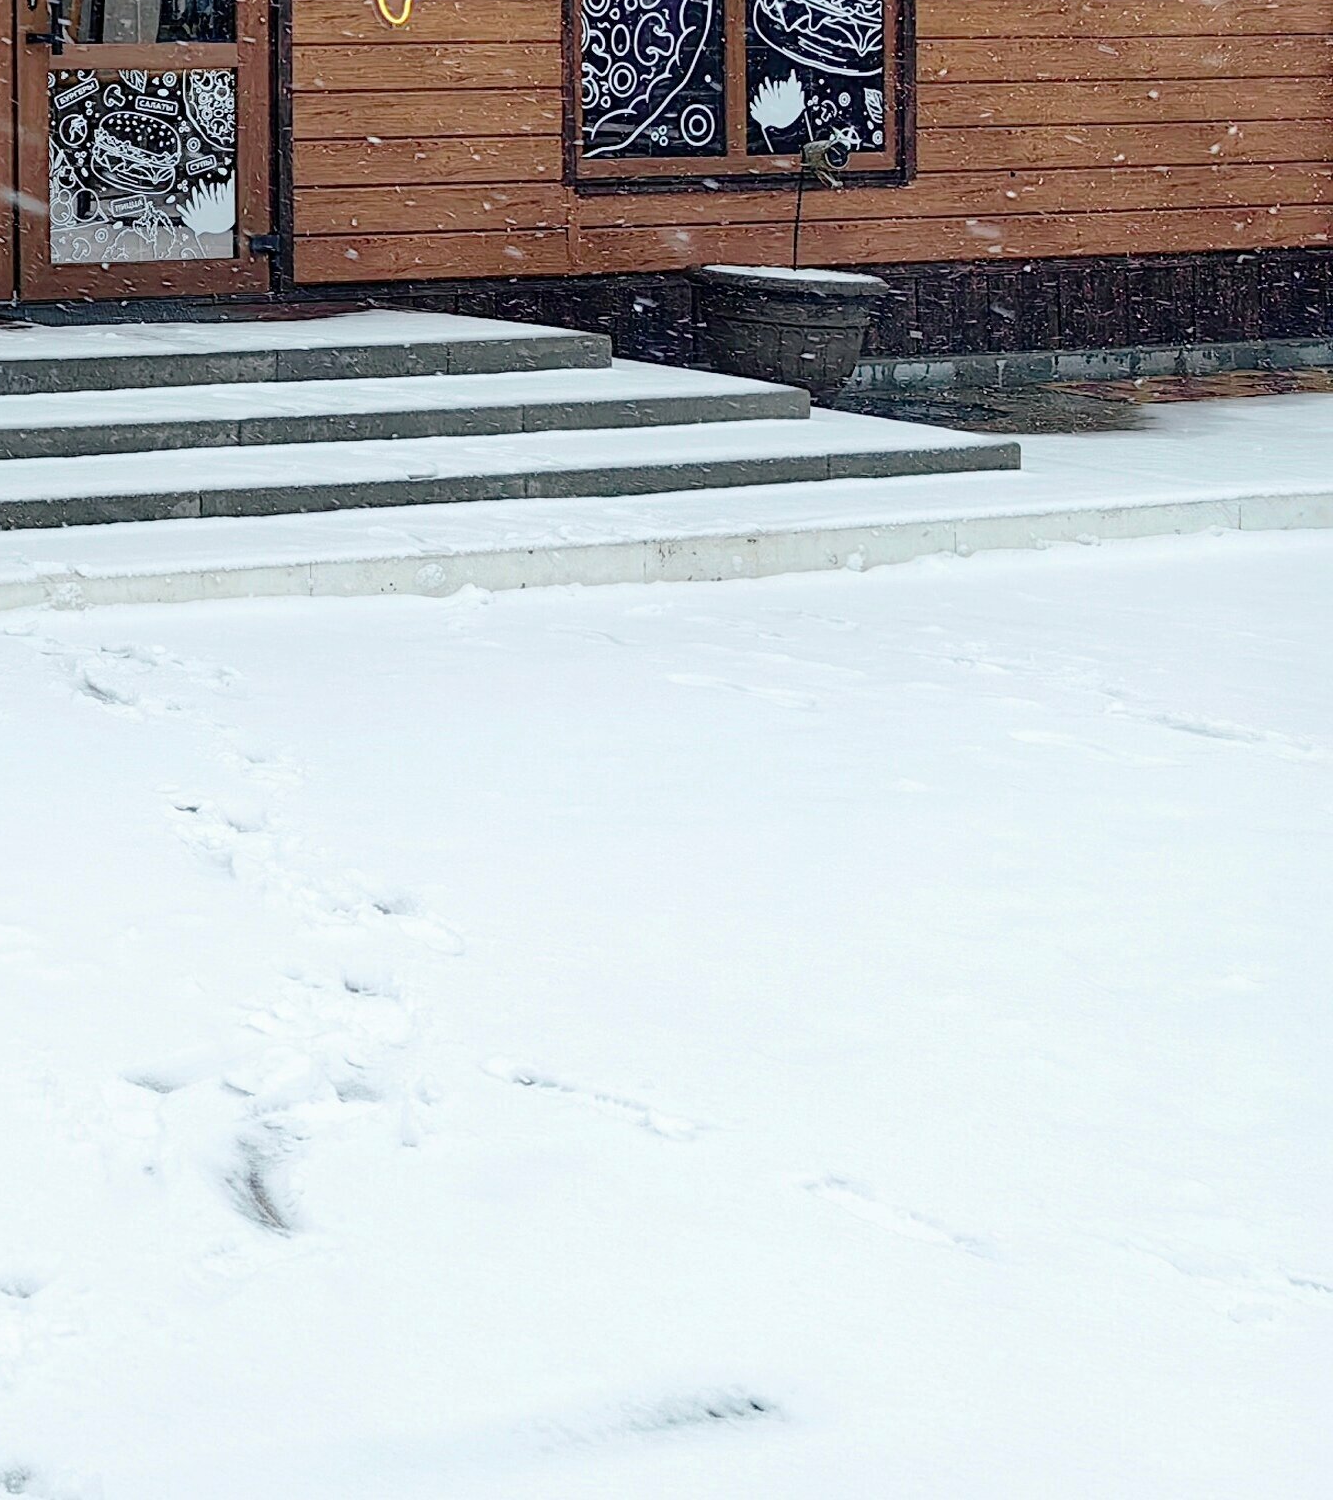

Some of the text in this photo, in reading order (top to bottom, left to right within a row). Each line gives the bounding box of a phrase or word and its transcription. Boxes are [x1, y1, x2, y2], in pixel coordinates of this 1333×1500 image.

[58, 82, 95, 105] БУРГЕРЫ
[138, 99, 174, 111] САЛАТЫ
[189, 158, 214, 172] СУПЫ
